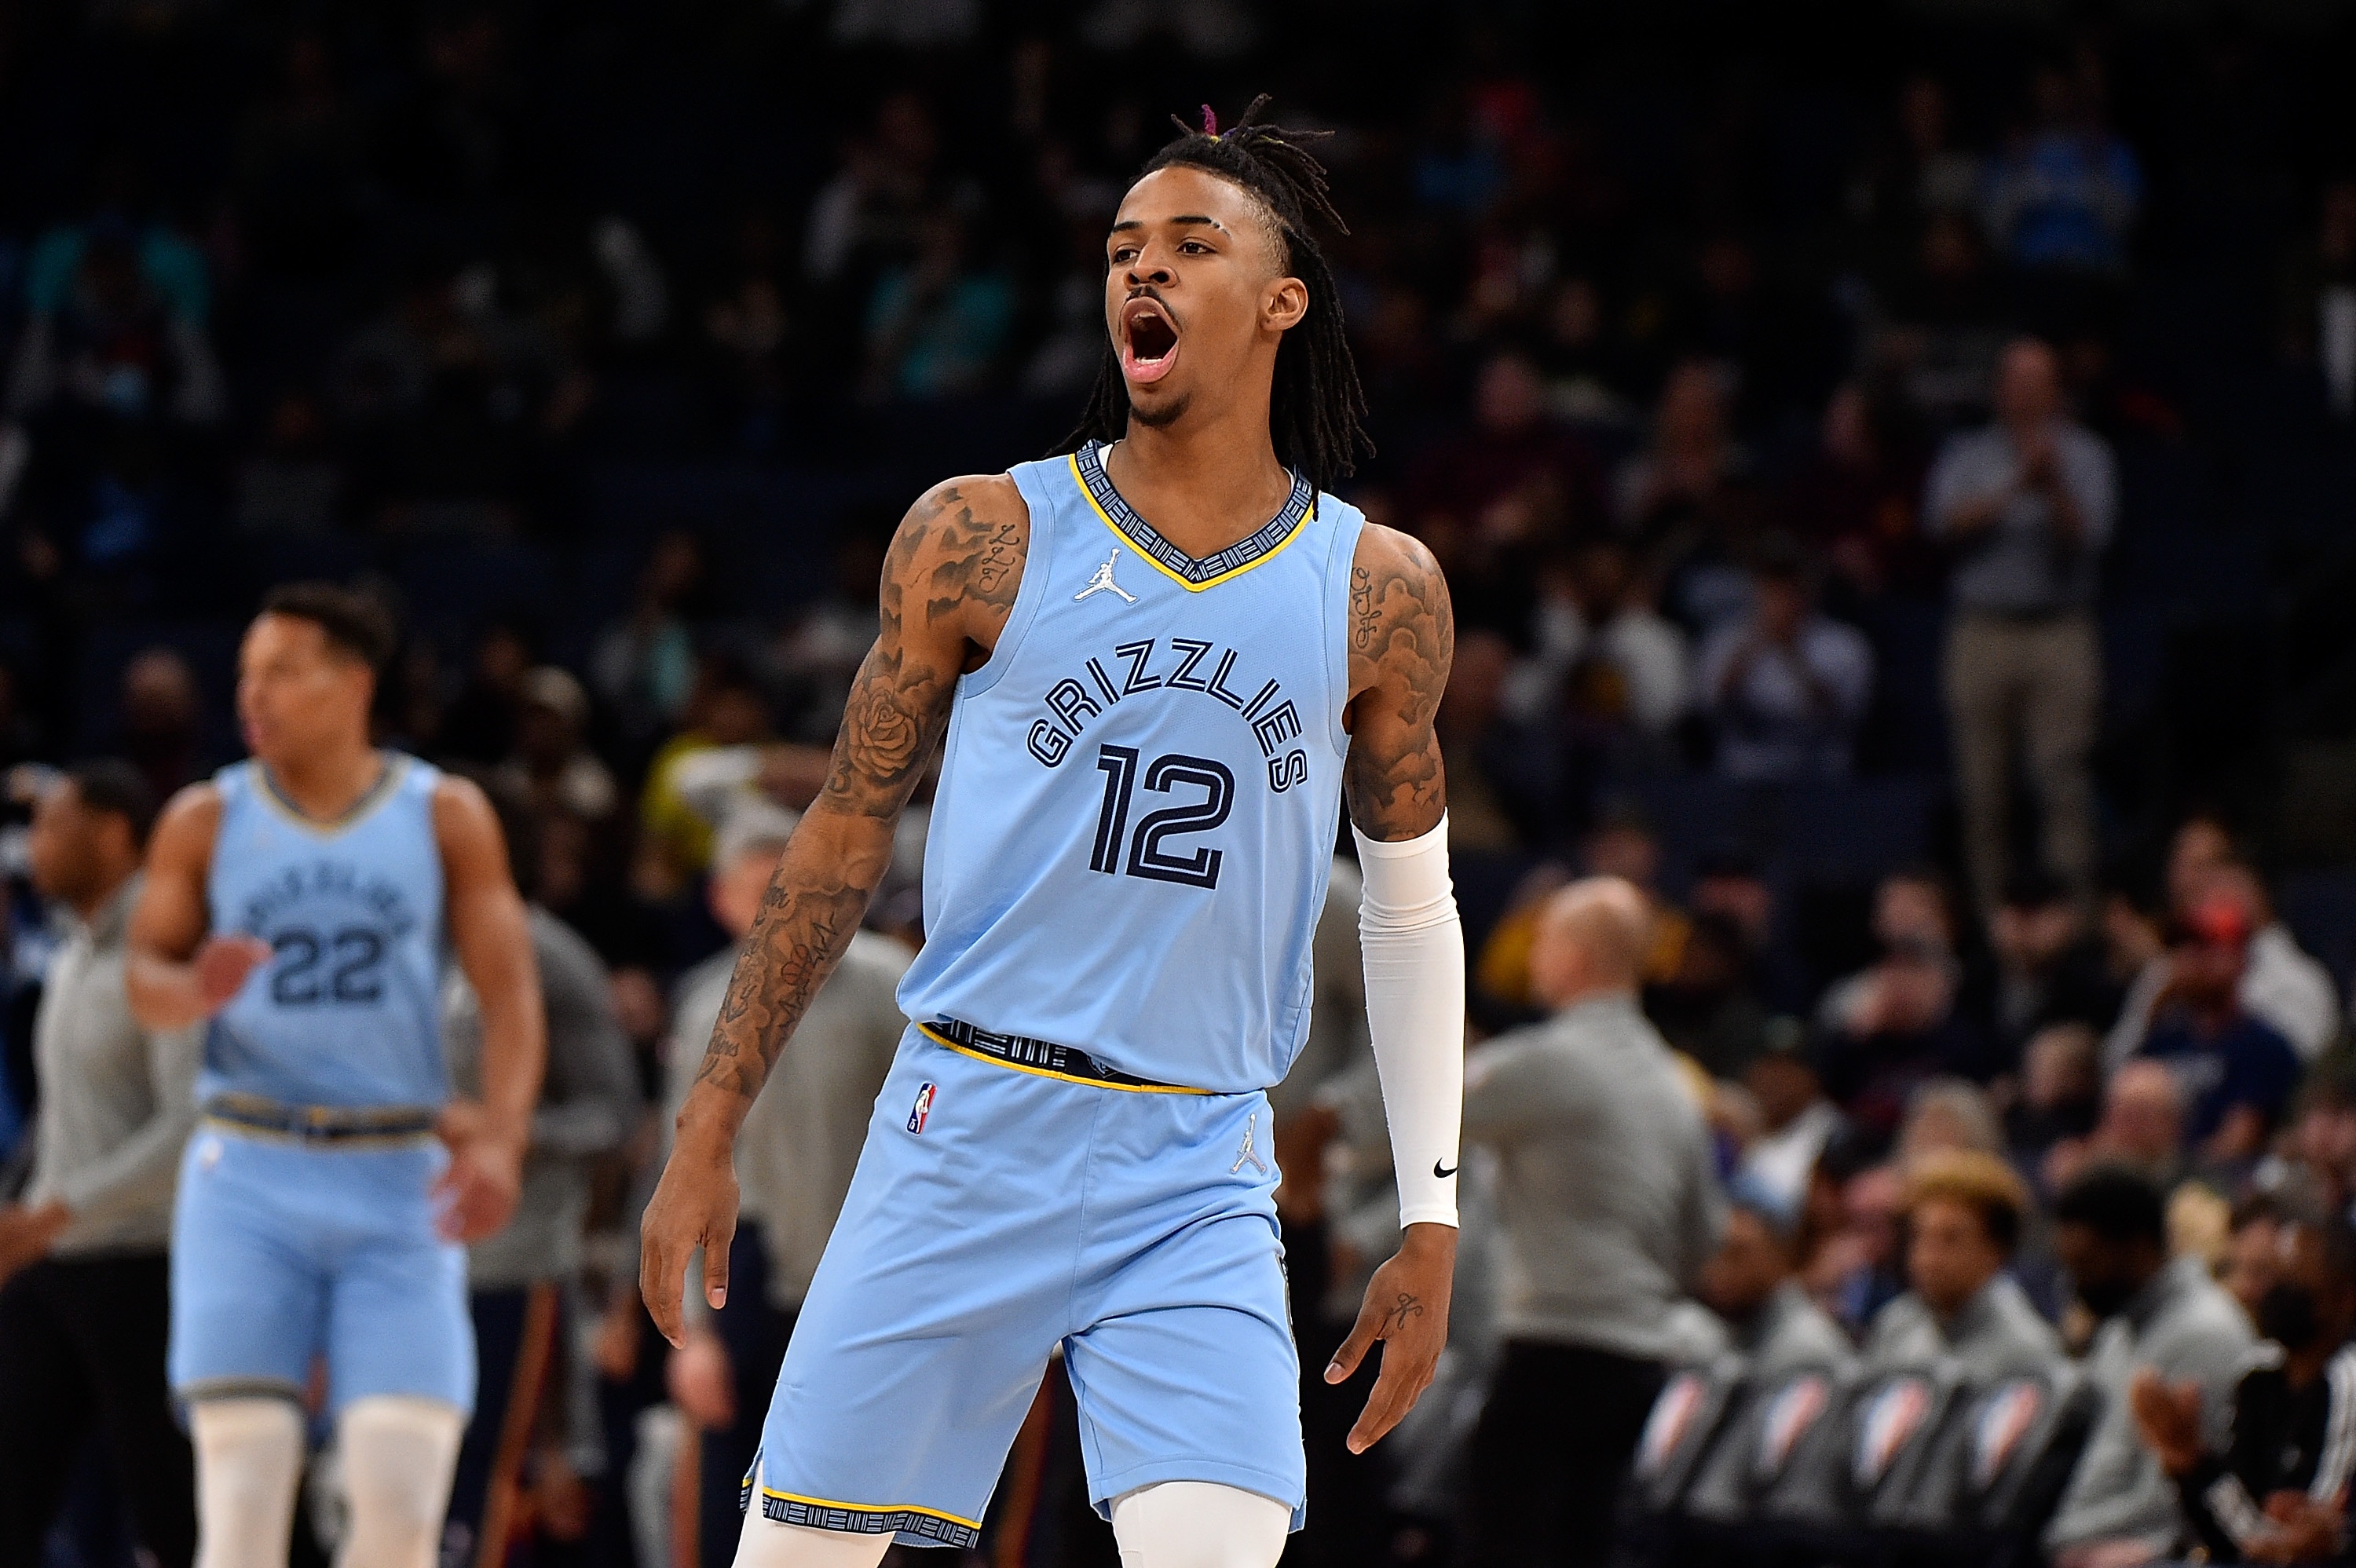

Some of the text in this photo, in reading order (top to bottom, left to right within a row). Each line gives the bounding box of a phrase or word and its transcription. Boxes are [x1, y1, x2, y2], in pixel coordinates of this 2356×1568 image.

[1026, 638, 1308, 794] GRIZZLIES
[1088, 743, 1236, 890] 12
[270, 926, 386, 1006] 22
